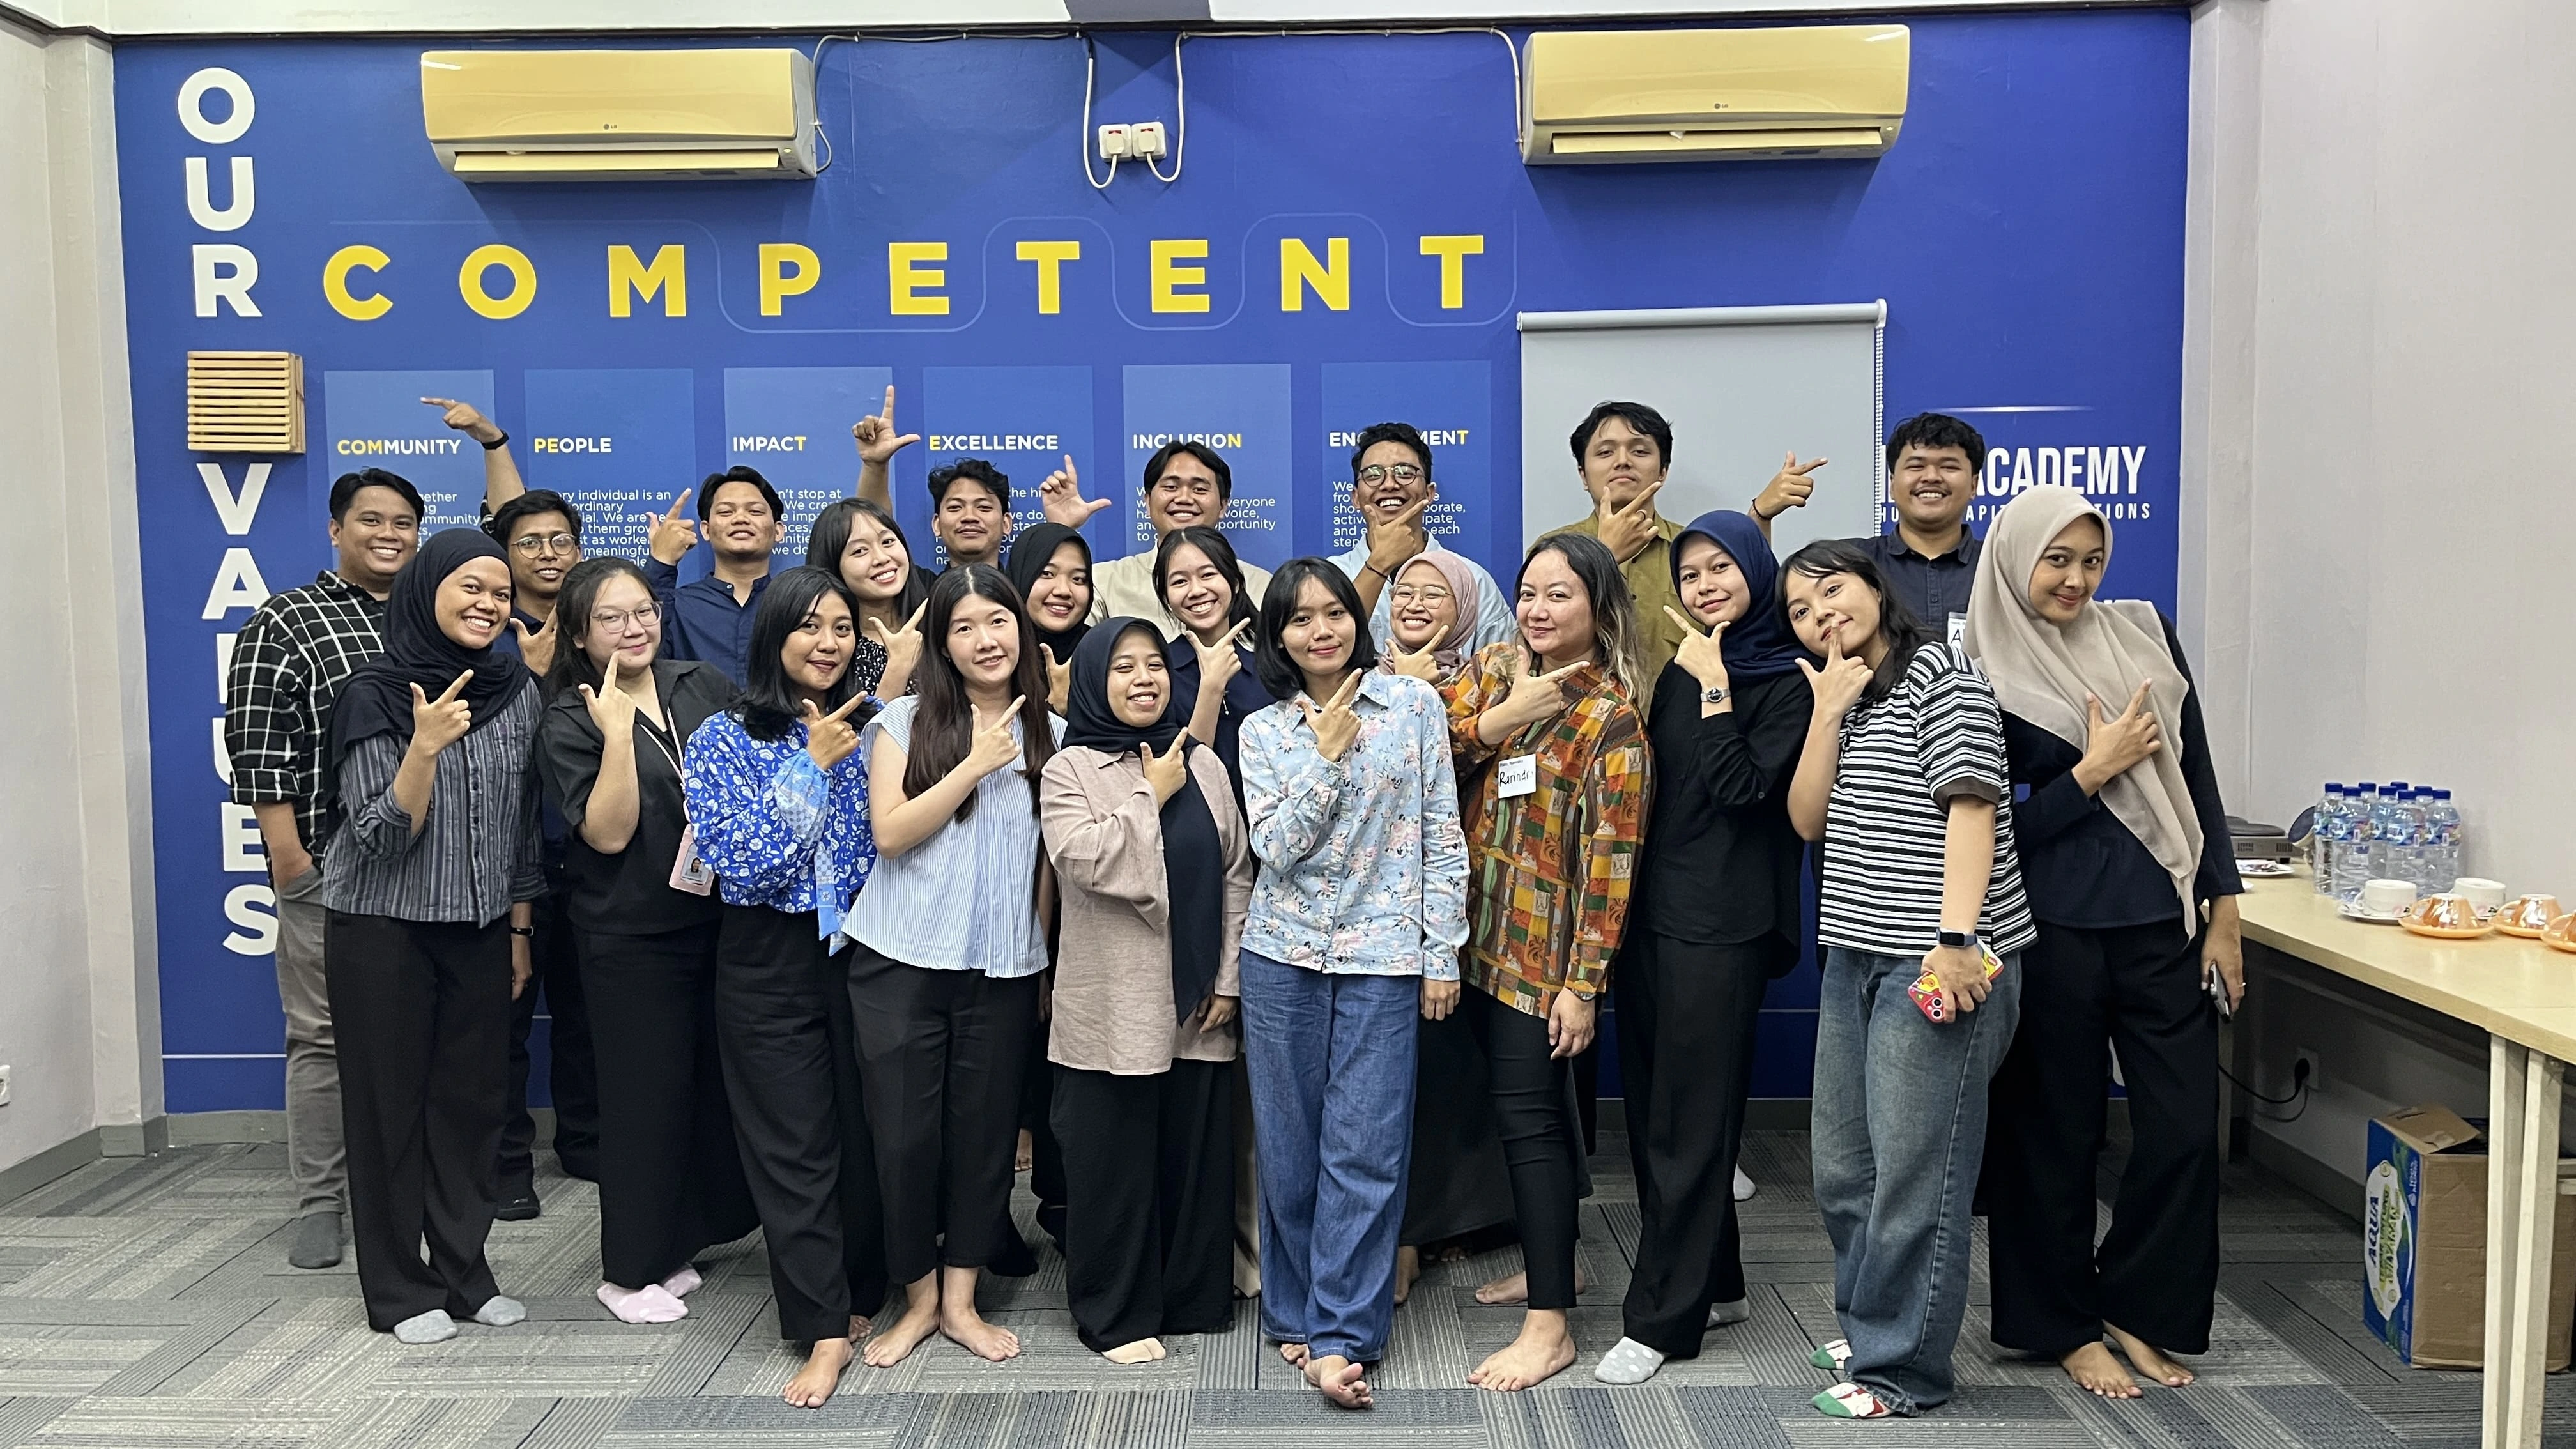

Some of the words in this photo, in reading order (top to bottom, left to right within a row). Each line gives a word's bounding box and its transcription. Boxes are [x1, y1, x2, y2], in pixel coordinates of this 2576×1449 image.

[178, 66, 263, 318] OUR
[323, 234, 1484, 320] COMPETENT
[732, 436, 807, 452] IMPACT
[929, 434, 1059, 450] EXCELLENCE
[1329, 429, 1469, 447] ENMENT
[337, 438, 461, 456] COMMUNITY
[533, 437, 612, 454] PEOPLE
[1976, 445, 2147, 497] CADEMY
[1333, 480, 1354, 491] We
[578, 489, 639, 501] individual
[642, 489, 652, 500] is
[656, 491, 671, 500] an
[778, 489, 794, 500] n't
[797, 489, 825, 501] stop
[829, 489, 842, 499] at
[1333, 491, 1351, 503] fro
[572, 501, 624, 513] ordinary
[783, 500, 805, 510] We
[1227, 498, 1276, 509] veryone
[1333, 503, 1360, 514] sho
[420, 513, 480, 526] mmunity
[602, 512, 624, 523] We
[627, 514, 647, 523] are
[1224, 509, 1260, 519] voice,
[1333, 514, 1367, 525] activ
[588, 523, 620, 534] them
[1215, 518, 1276, 531] portunity
[1333, 525, 1356, 536] and
[1430, 523, 1460, 535] each
[609, 534, 650, 545] worke
[1137, 532, 1150, 542] to
[583, 545, 650, 558] meaningfu
[772, 546, 789, 555] we
[196, 463, 277, 956] VAES
[2368, 1196, 2379, 1269] AQUA
